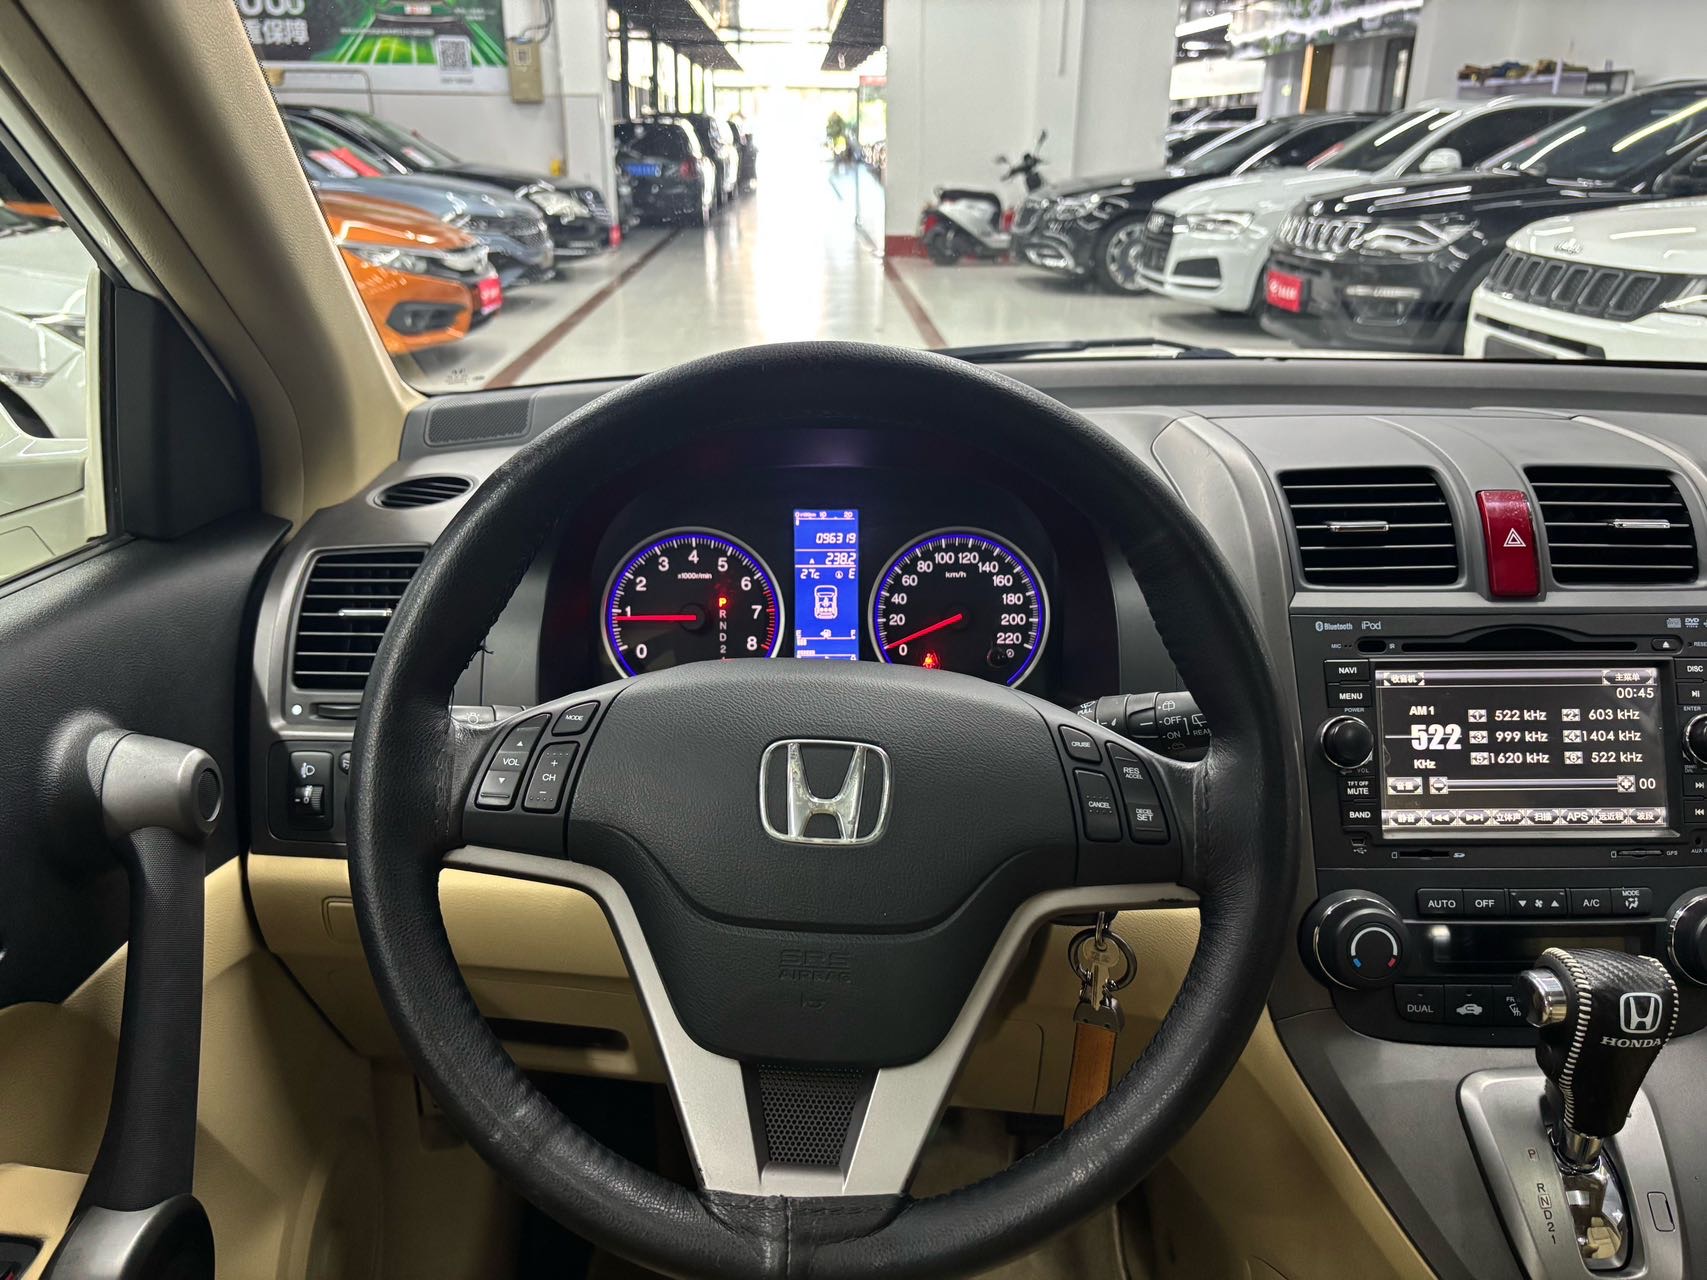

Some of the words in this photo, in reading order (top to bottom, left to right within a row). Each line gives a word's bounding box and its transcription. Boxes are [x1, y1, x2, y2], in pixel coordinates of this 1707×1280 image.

[816, 532, 857, 544] 096319
[688, 550, 699, 564] 4
[934, 552, 954, 564] 100
[958, 552, 979, 564] 120
[658, 557, 670, 572] 3
[718, 557, 728, 572] 5
[917, 561, 933, 573] 80
[978, 562, 998, 574] 140
[636, 577, 647, 591] 2
[740, 577, 752, 591] 6
[902, 575, 918, 587] 60
[992, 575, 1013, 587] 160
[718, 598, 727, 607] P
[891, 593, 907, 605] 40
[1002, 594, 1023, 605] 180
[625, 606, 632, 617] 1
[719, 610, 727, 618] R
[752, 605, 762, 620] 7
[889, 614, 906, 626] 20
[1001, 614, 1026, 626] 200
[1361, 621, 1382, 630] iPod
[719, 622, 727, 630] N
[1324, 622, 1353, 630] Bluetooth
[719, 633, 727, 641] D
[996, 633, 1022, 644] 220
[746, 636, 758, 650] 8
[636, 644, 648, 659] 0
[720, 644, 726, 654] 2
[898, 644, 908, 656] 0
[1687, 665, 1704, 673] DISC
[1339, 692, 1363, 700] MENU
[1616, 687, 1654, 698] 00:45
[1494, 710, 1520, 721] 522
[1524, 709, 1547, 720] kHz
[1588, 709, 1614, 720] 603
[1617, 708, 1640, 720] kHz
[1163, 716, 1182, 726] OFF
[1410, 724, 1462, 750] 522
[1496, 730, 1521, 742] 999
[1525, 730, 1548, 742] kHz
[1582, 730, 1616, 742] 1404
[1618, 730, 1642, 742] kHz
[502, 758, 520, 766] VOL
[1490, 752, 1523, 764] 1620
[1526, 752, 1550, 764] kHz
[1591, 752, 1616, 763] 522
[1620, 752, 1643, 763] kHz
[1413, 759, 1436, 770] KHz
[542, 774, 556, 782] CH
[1639, 778, 1656, 790] 00
[1347, 787, 1369, 795] MUTE
[1088, 800, 1111, 809] CANCEL
[1136, 814, 1154, 822] SET
[1349, 811, 1371, 819] BAND
[1566, 811, 1589, 822] APS
[1428, 900, 1456, 909] AUTO
[1474, 899, 1495, 908] OFF
[1582, 898, 1600, 908] A/C
[1406, 1004, 1434, 1014] DUAL
[1600, 1036, 1662, 1048] HONDA
[1528, 1149, 1536, 1160] P
[1536, 1183, 1546, 1193] R
[1541, 1196, 1550, 1206] N
[1544, 1210, 1553, 1220] D
[1548, 1222, 1556, 1232] 2
[1552, 1234, 1556, 1244] 1
